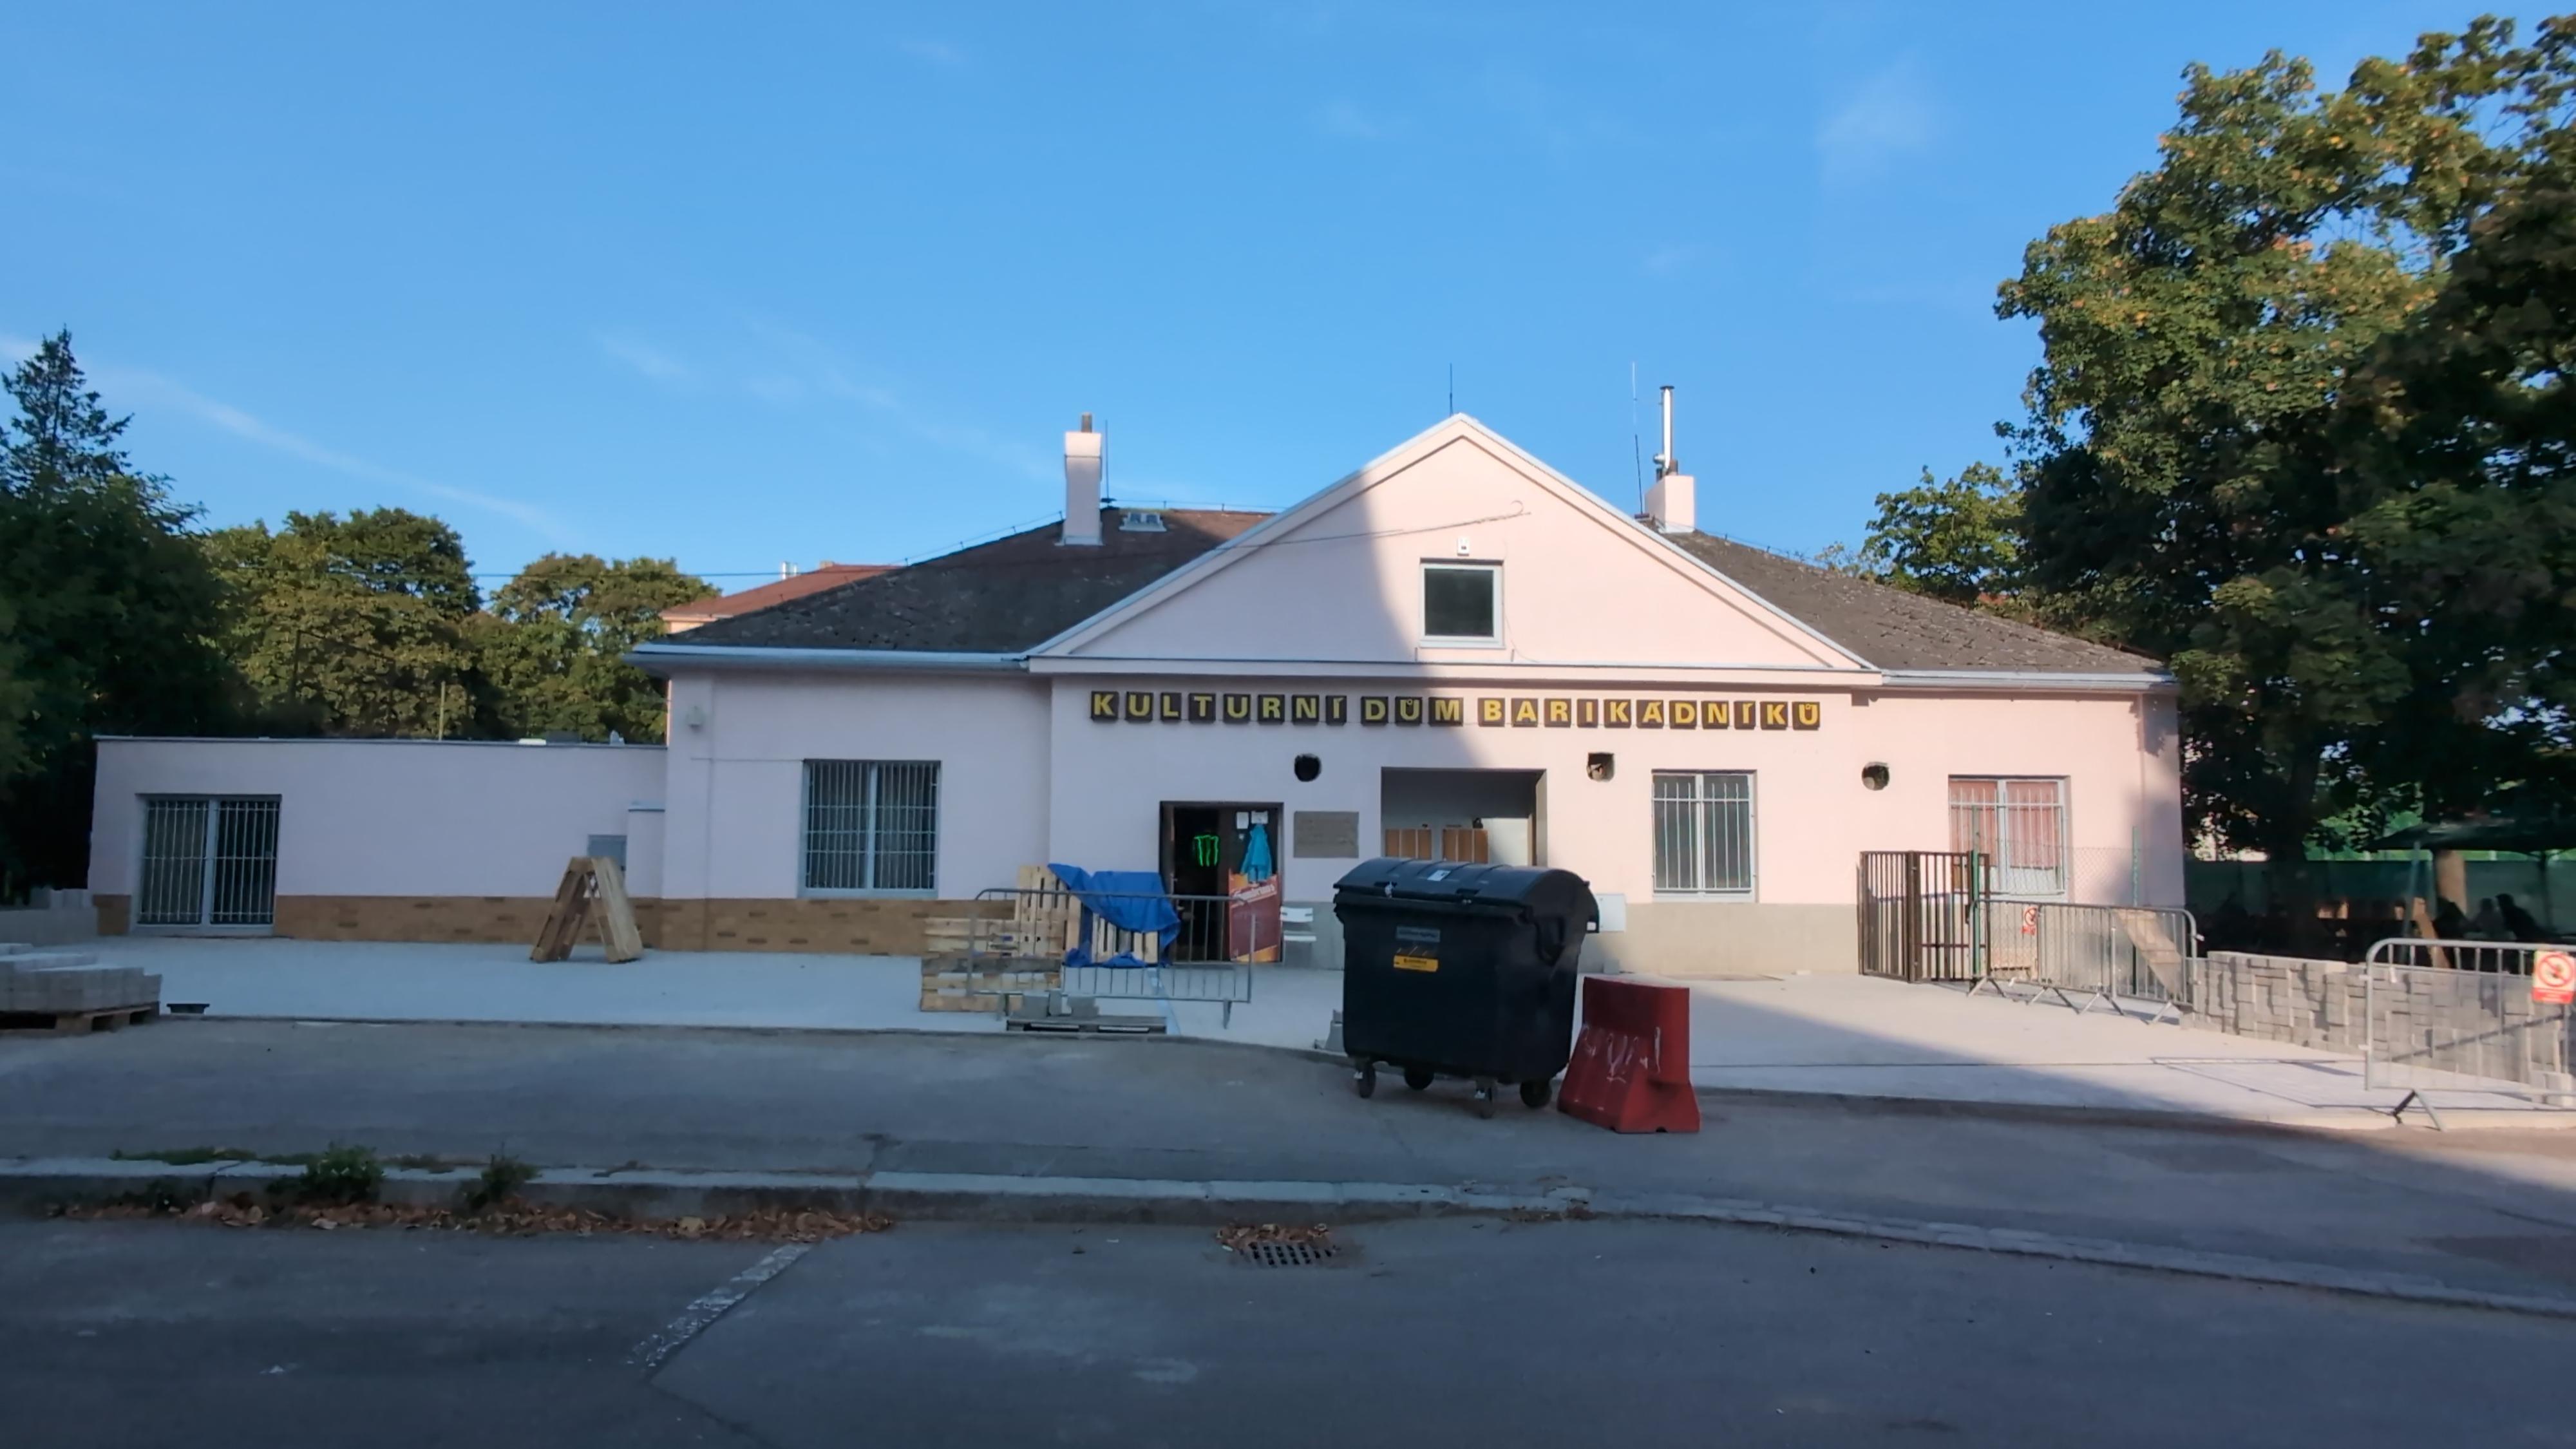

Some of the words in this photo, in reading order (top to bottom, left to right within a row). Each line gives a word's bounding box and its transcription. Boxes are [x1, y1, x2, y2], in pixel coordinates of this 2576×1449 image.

[1095, 694, 1345, 719] KULTURNÍ
[1365, 697, 1460, 721] DŮM
[1483, 699, 1819, 726] BARIKÁDNÍKŮ
